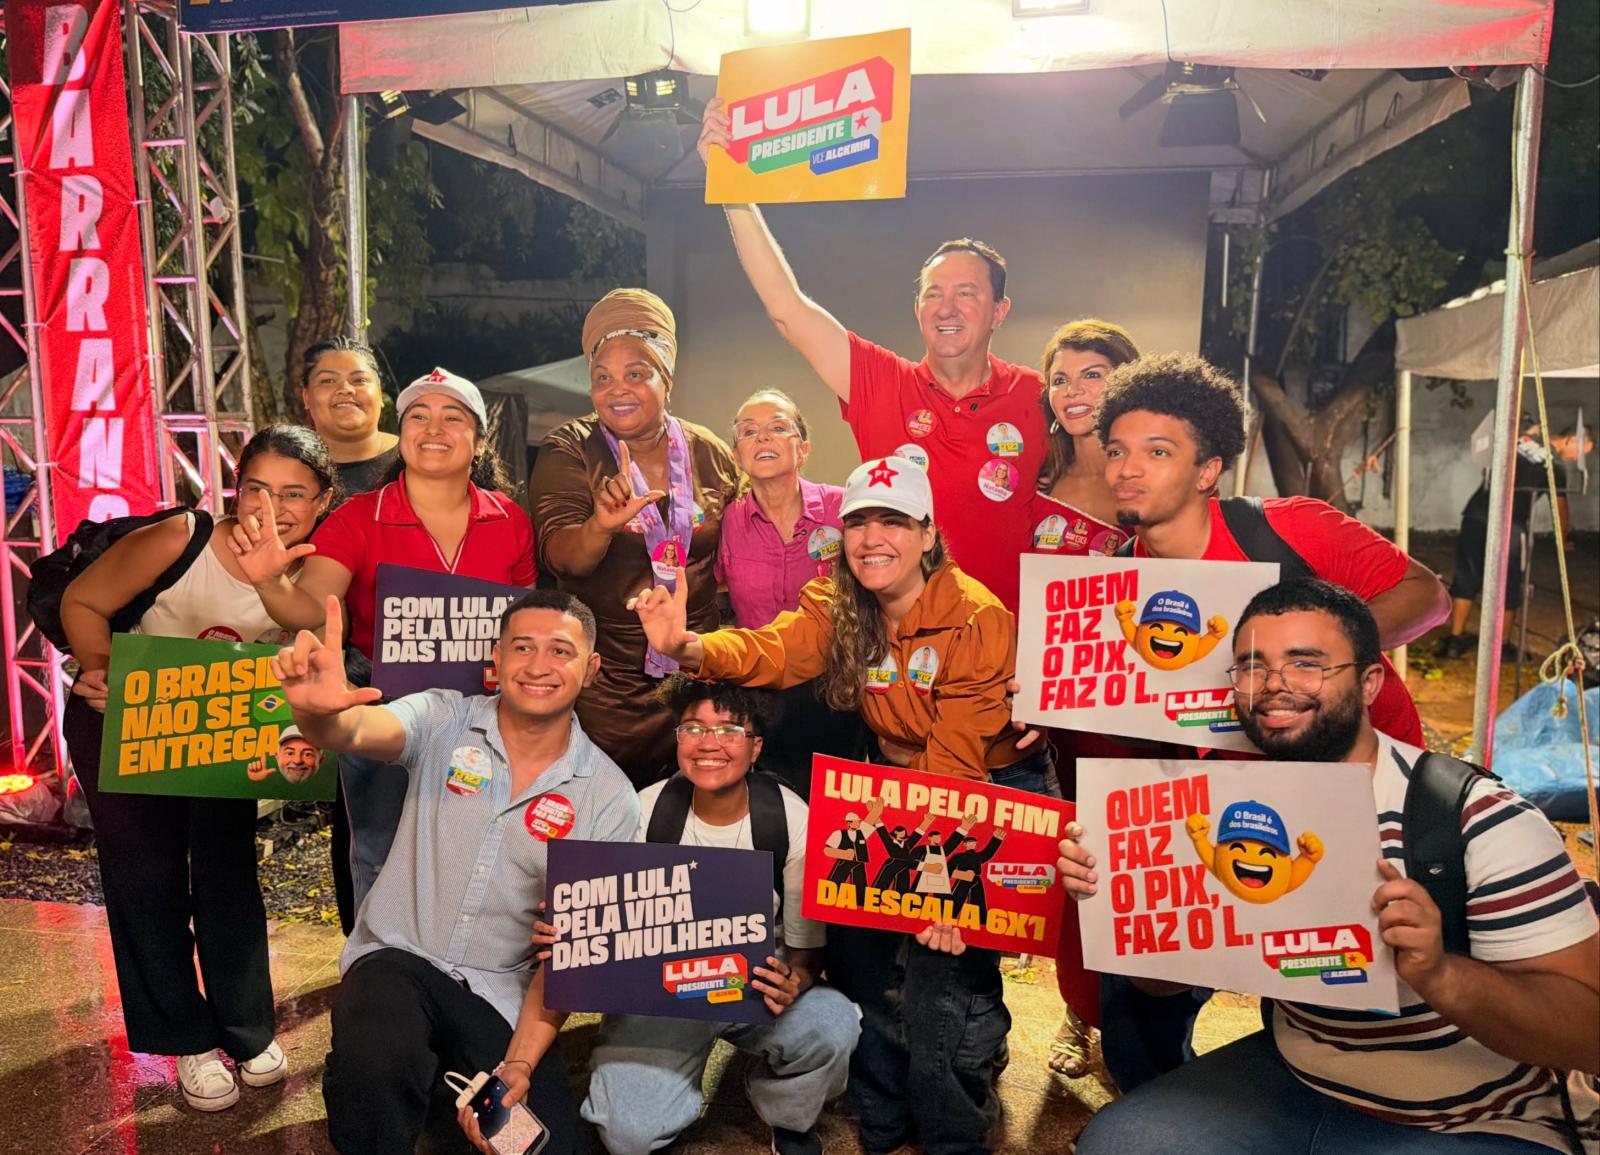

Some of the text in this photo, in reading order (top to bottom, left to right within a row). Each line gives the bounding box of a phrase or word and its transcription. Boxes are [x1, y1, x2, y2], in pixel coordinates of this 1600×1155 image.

[731, 67, 876, 141] LULA
[751, 120, 845, 162] PRESIDENTE
[812, 138, 871, 165] VICE ALCKMIN
[874, 470, 890, 479] PT
[383, 597, 508, 618] COM LULA
[1045, 569, 1139, 613] QUEM
[1157, 597, 1165, 606] O
[383, 618, 447, 640] PELA
[1045, 609, 1103, 645] FAZ
[381, 640, 436, 663] DAS
[1042, 639, 1136, 678] O PIX,
[124, 655, 282, 705] O BRASIL
[1039, 671, 1159, 712] FAZ O L.
[121, 694, 251, 741] NÃO SE
[1177, 710, 1228, 721] PRESIDENTE
[119, 724, 280, 777] ENTREGA
[824, 769, 1060, 838] LULA PELO FIM
[1106, 774, 1210, 831] QUEM
[1234, 811, 1241, 819] O
[1243, 811, 1266, 822] Brasil
[1229, 820, 1241, 828] dos
[1109, 825, 1173, 872] FAZ
[553, 863, 692, 913] COM LULA
[990, 864, 1047, 876] LULA
[1110, 864, 1220, 914] O PIX,
[552, 893, 694, 941] PELA VIDA
[816, 878, 1046, 941] DA ESCALA 6X1
[552, 913, 768, 971] DAS MULHERES
[1113, 905, 1254, 956] FAZ O L.
[1264, 928, 1360, 956] LULA
[665, 957, 739, 982] LULA
[1280, 955, 1342, 970] PRESIDENTE
[677, 979, 725, 993] PRESIDENTE
